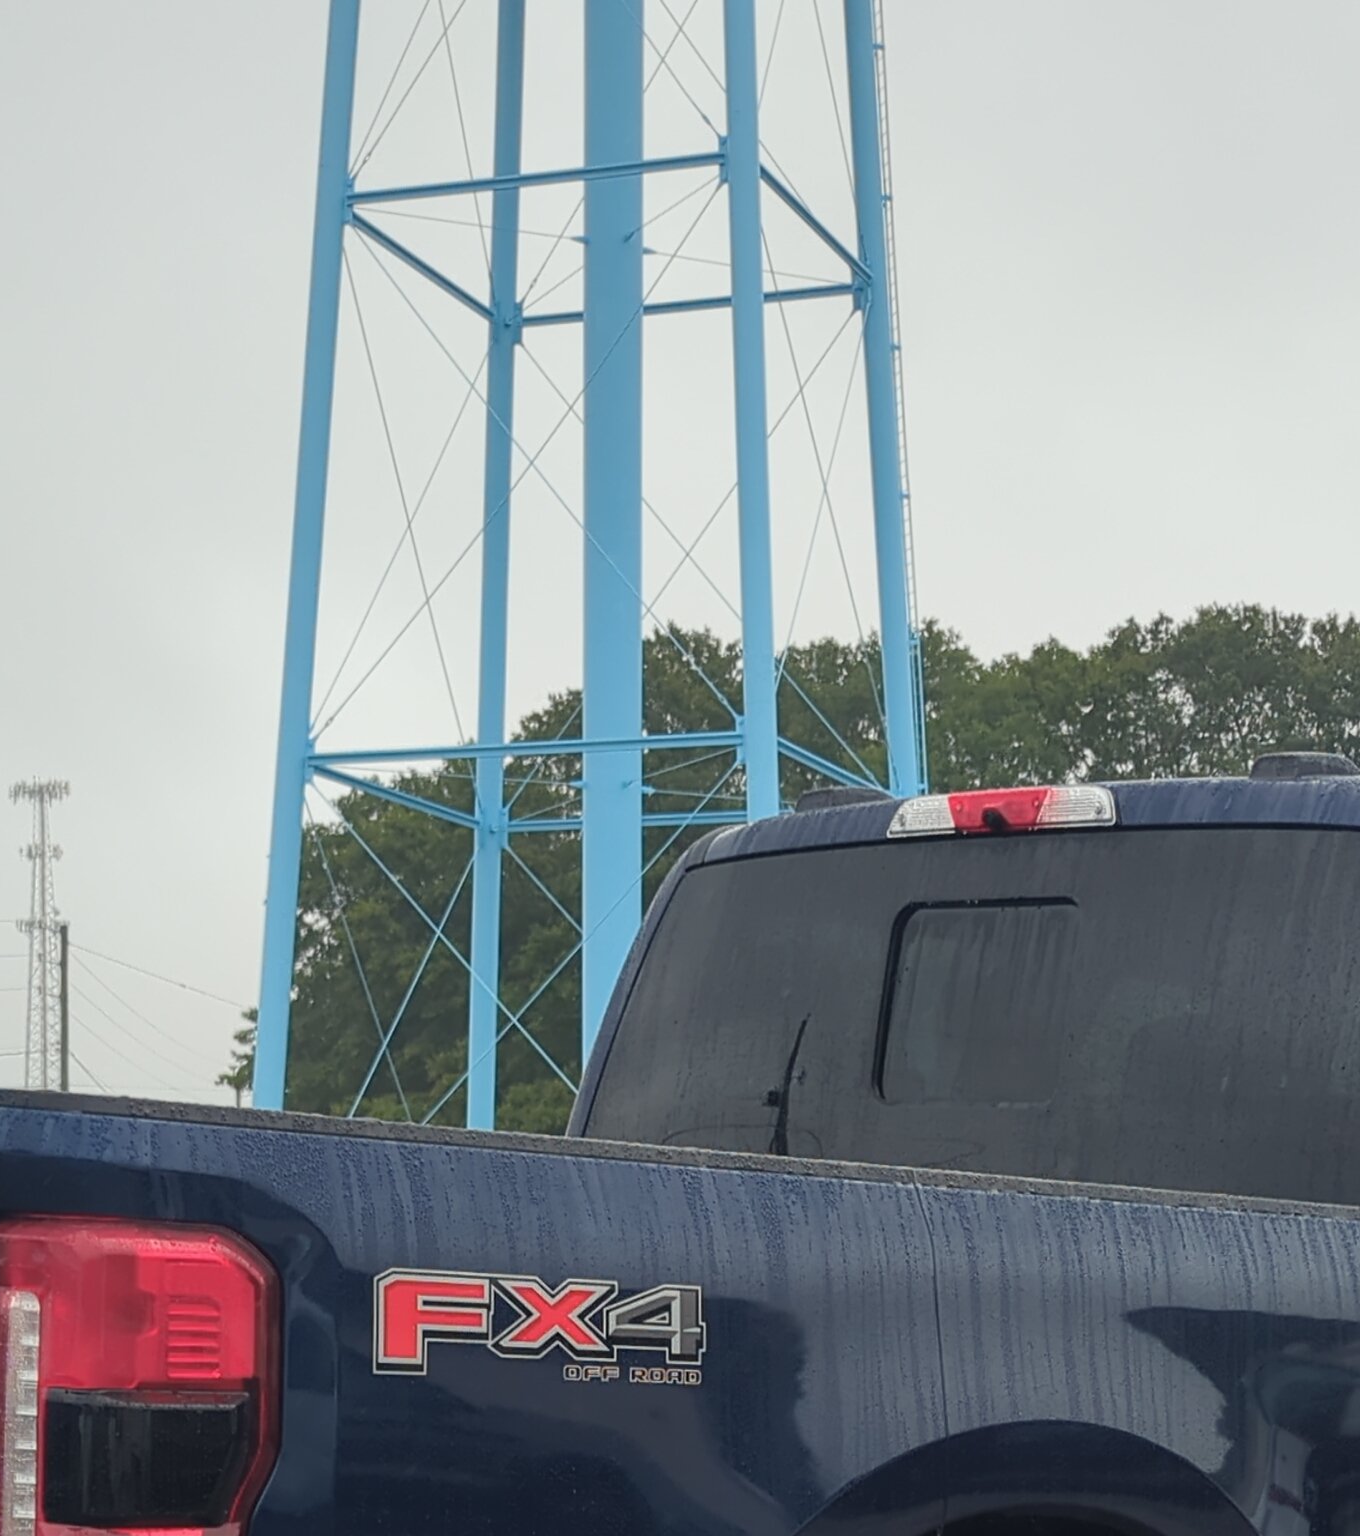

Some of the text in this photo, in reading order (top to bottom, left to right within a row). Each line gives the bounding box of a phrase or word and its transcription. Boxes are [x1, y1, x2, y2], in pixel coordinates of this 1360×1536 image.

[373, 1267, 706, 1375] FX4
[563, 1364, 702, 1385] OFF ROAD
